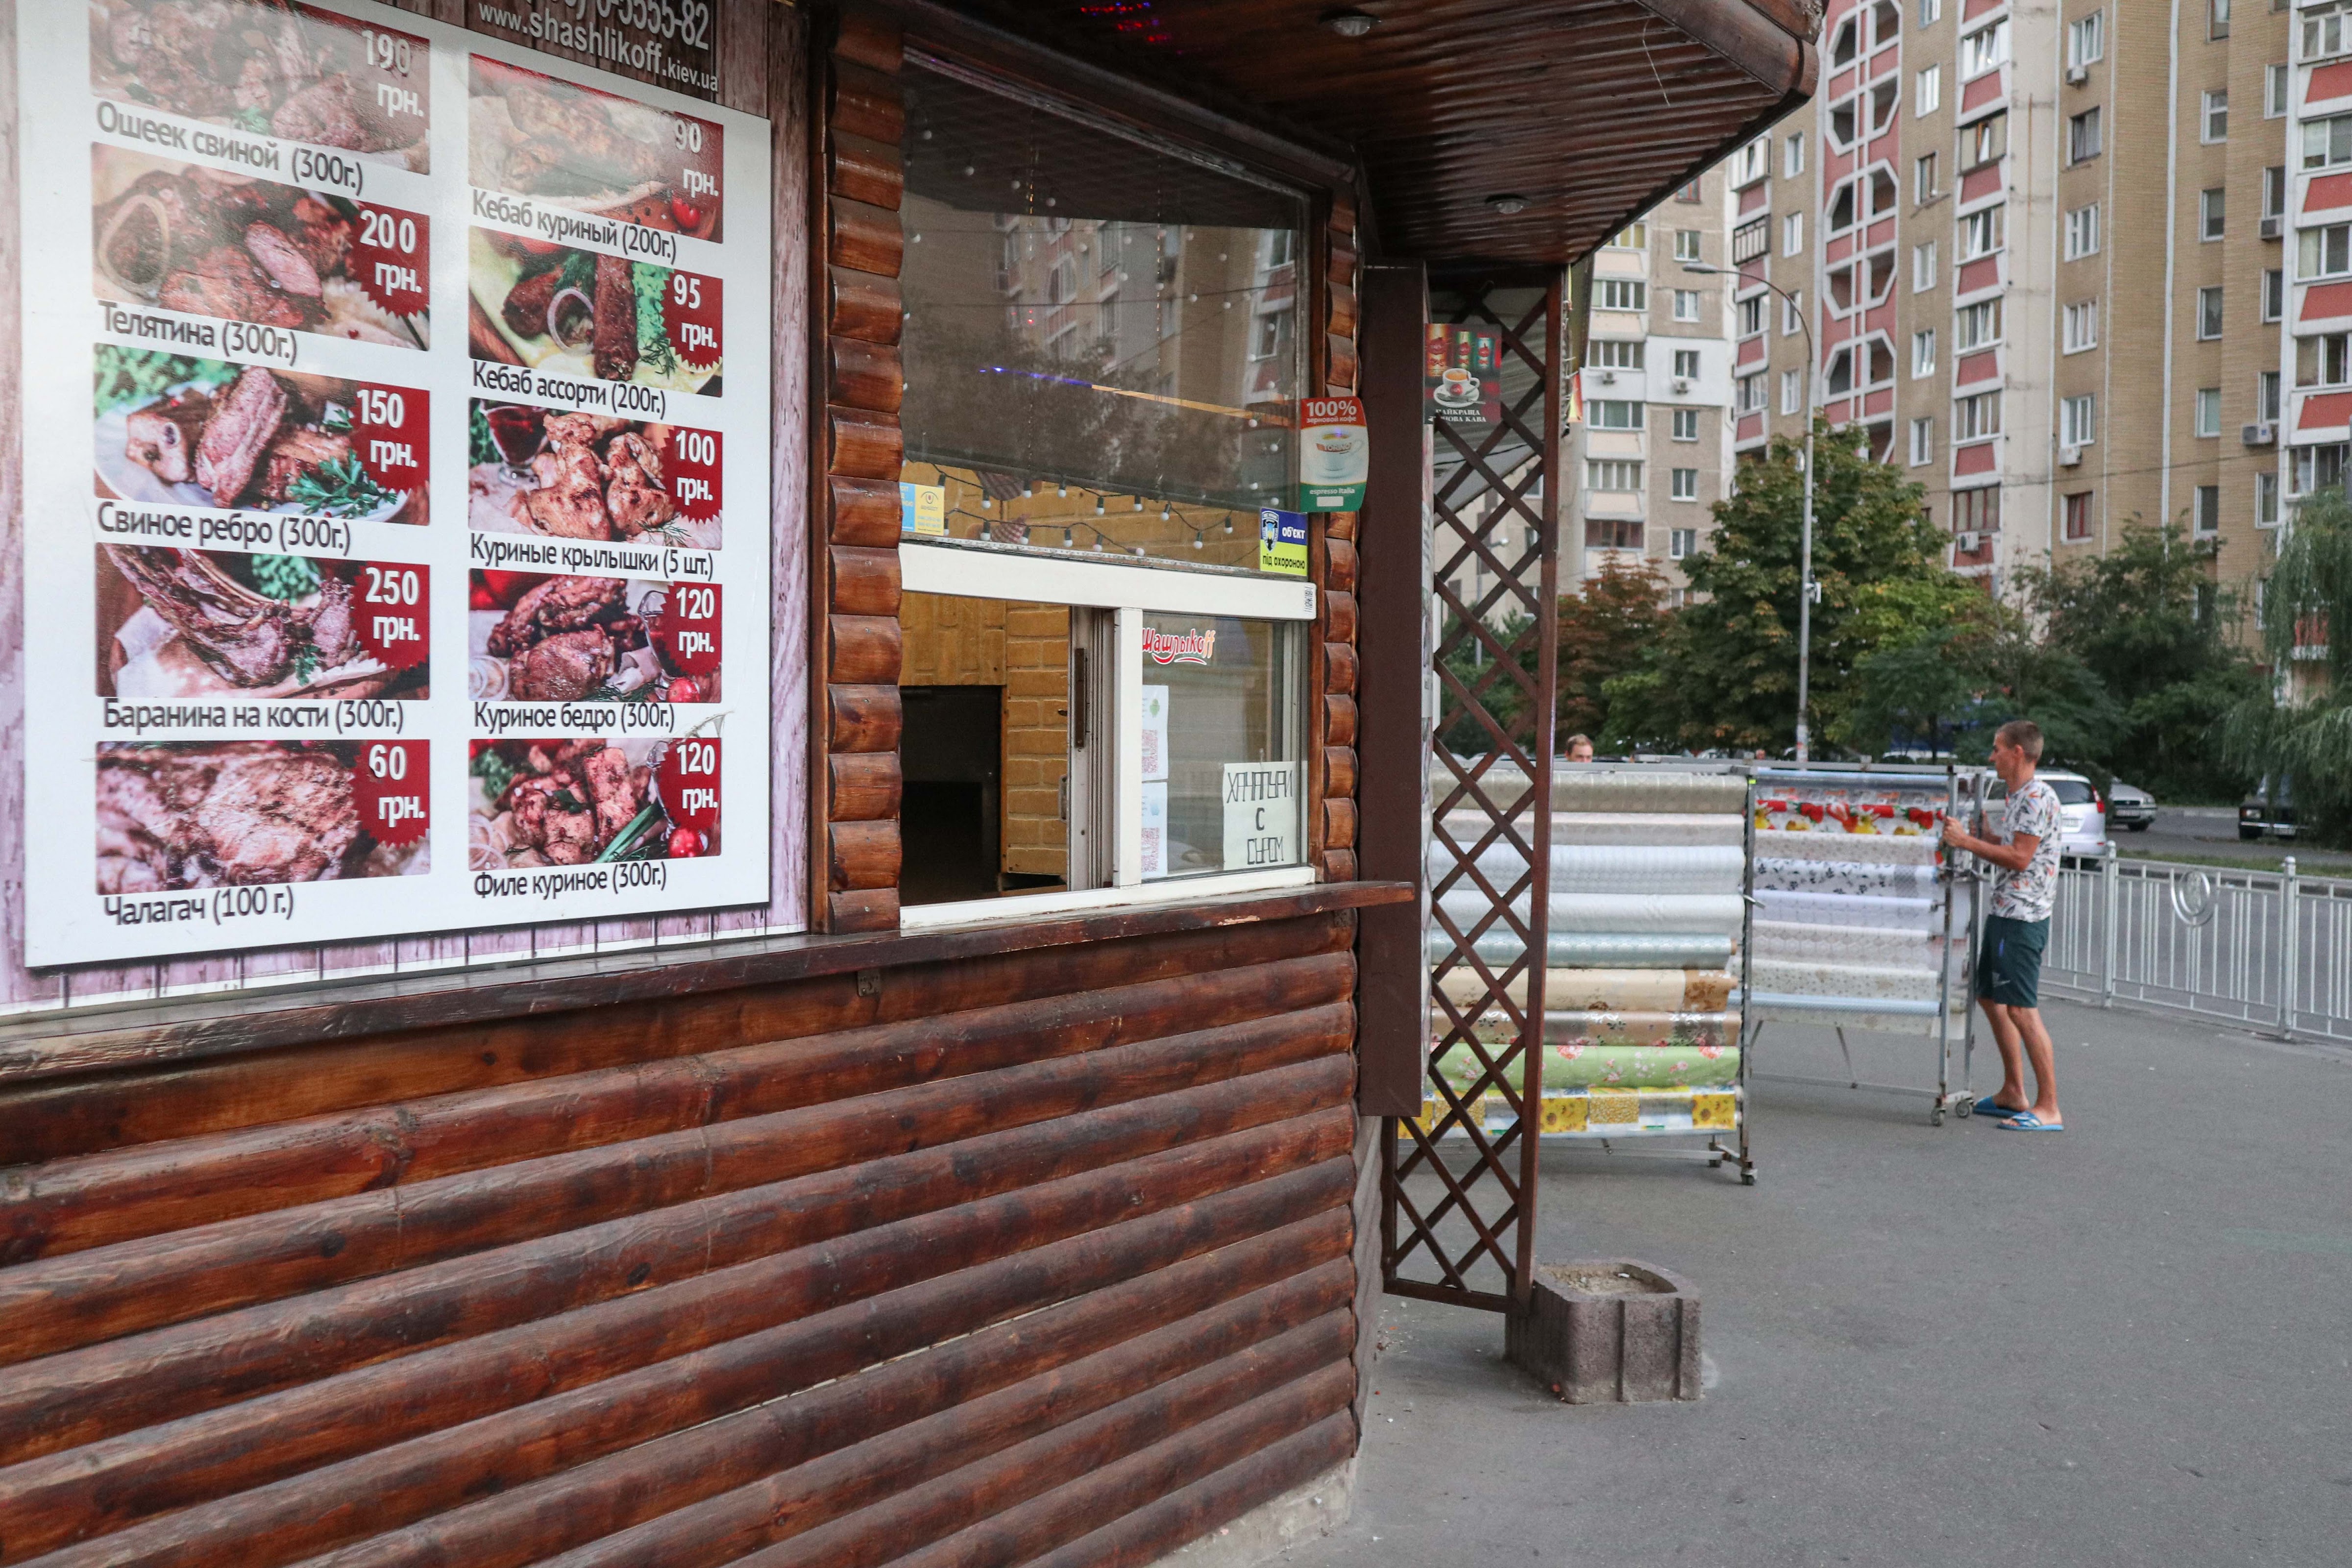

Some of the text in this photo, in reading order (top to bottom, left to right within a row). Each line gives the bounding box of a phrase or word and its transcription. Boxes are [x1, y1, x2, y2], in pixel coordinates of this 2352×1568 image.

[362, 29, 411, 77] 190
[479, 4, 718, 92] www.shashlikoff.kiev.ua
[378, 82, 424, 118] грн.
[98, 100, 364, 196] Ошеек свиной (300г.)
[673, 121, 702, 154] 90
[683, 167, 719, 198] грн.
[360, 210, 416, 254] 200
[472, 190, 676, 265] Кебаб куриный (200г.)
[374, 263, 422, 297] грн.
[673, 274, 701, 309] 95
[98, 300, 296, 367] Телятина (300г.)
[682, 322, 718, 351] грн.
[472, 361, 666, 420] Кебаб ассорти (200г.)
[1307, 400, 1357, 417] 100%
[356, 390, 404, 428] 150
[370, 441, 418, 473] грн.
[675, 430, 715, 466] 100
[677, 477, 713, 506] грн.
[98, 501, 350, 557] Свиное ребро (300г.)
[470, 533, 713, 582] Куриные крылышки (5 шт.)
[1262, 554, 1306, 569] під охороною
[366, 567, 419, 605] 250
[675, 587, 715, 619] 120
[373, 618, 420, 648] грн.
[678, 631, 715, 659] грн.
[103, 698, 403, 735] Баранина на кости (300г.)
[474, 702, 675, 734] Куриное бедро (300г.)
[369, 744, 407, 781] 60
[677, 742, 715, 775] 120
[378, 796, 425, 828] грн.
[682, 788, 718, 816] грн.
[474, 861, 666, 900] Филе куриное (300г.)
[103, 884, 294, 926] Чалагач (100 г.)
